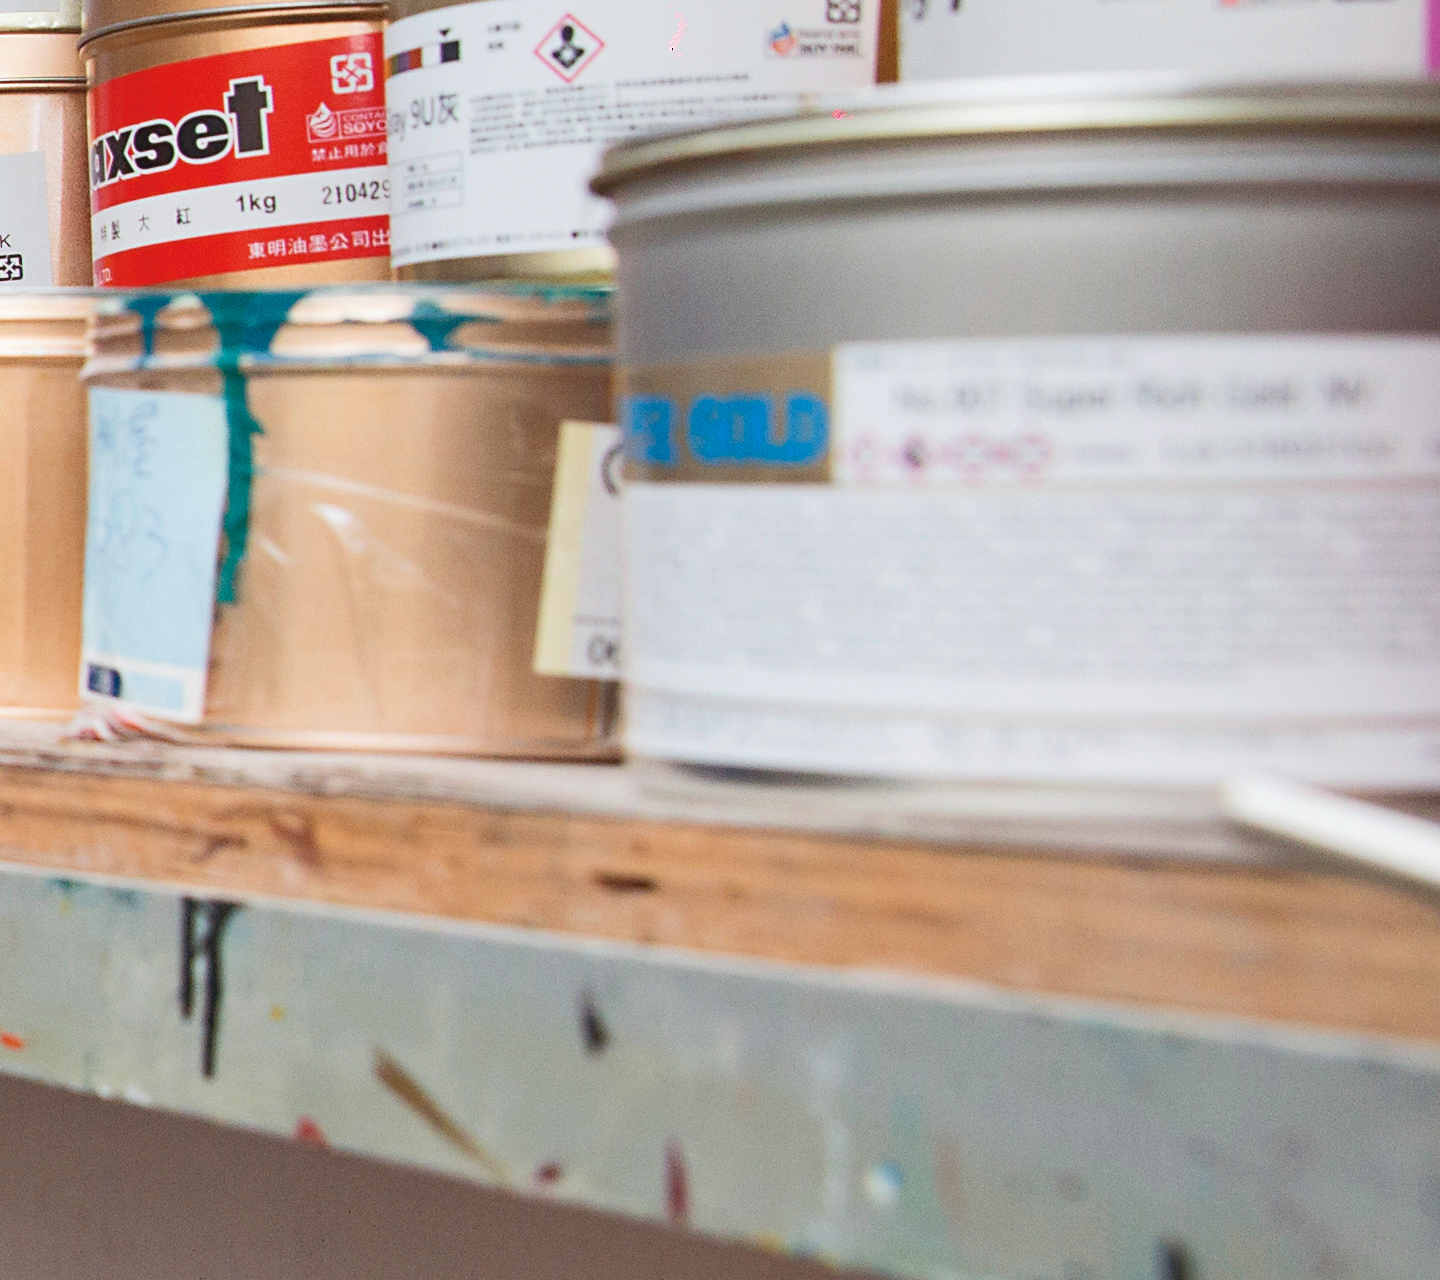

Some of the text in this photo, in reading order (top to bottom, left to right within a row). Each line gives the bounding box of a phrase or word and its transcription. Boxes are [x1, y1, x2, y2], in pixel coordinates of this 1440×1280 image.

[343, 111, 386, 122] CONTA
[343, 122, 386, 136] SOYO
[236, 194, 277, 213] 1kg
[322, 179, 390, 206] 210429
[687, 392, 830, 465] GOLD
